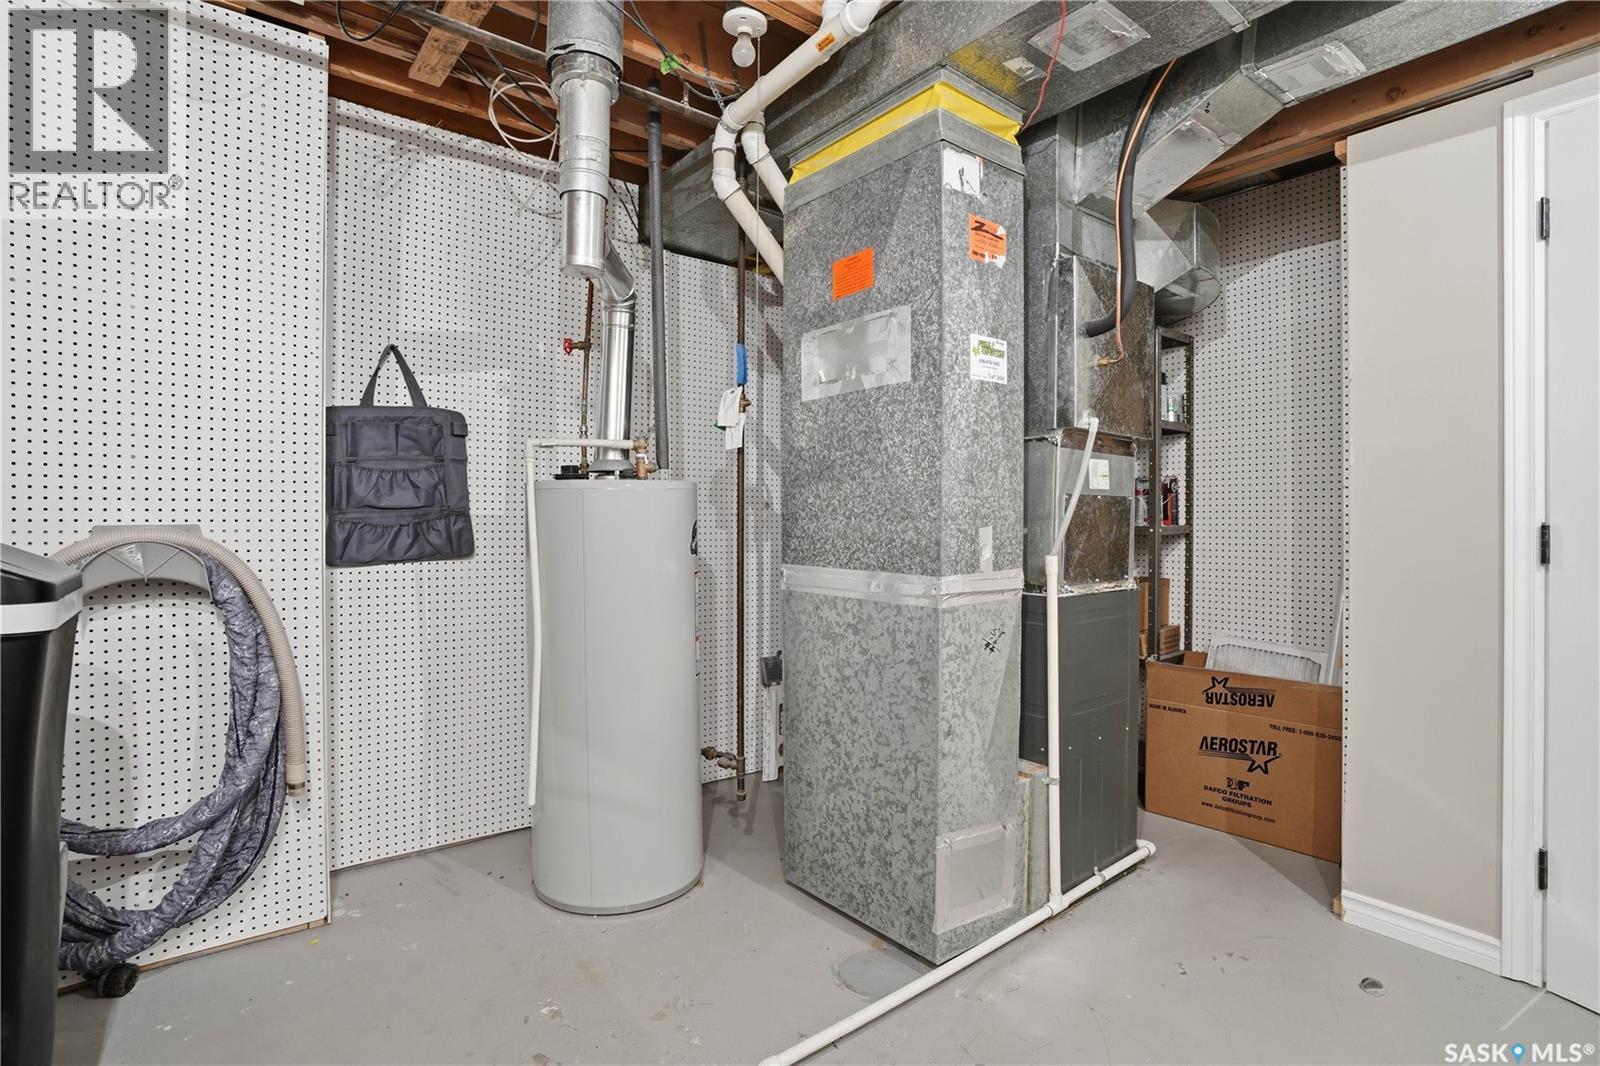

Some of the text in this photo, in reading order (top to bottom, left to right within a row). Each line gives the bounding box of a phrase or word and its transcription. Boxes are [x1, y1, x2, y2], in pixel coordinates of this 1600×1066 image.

[1205, 692, 1275, 708] AEROSTAR
[1199, 736, 1278, 756] AEROSTAR
[1203, 784, 1273, 806] DAFCO FILTRATION
[1221, 796, 1252, 808] GROUPE
